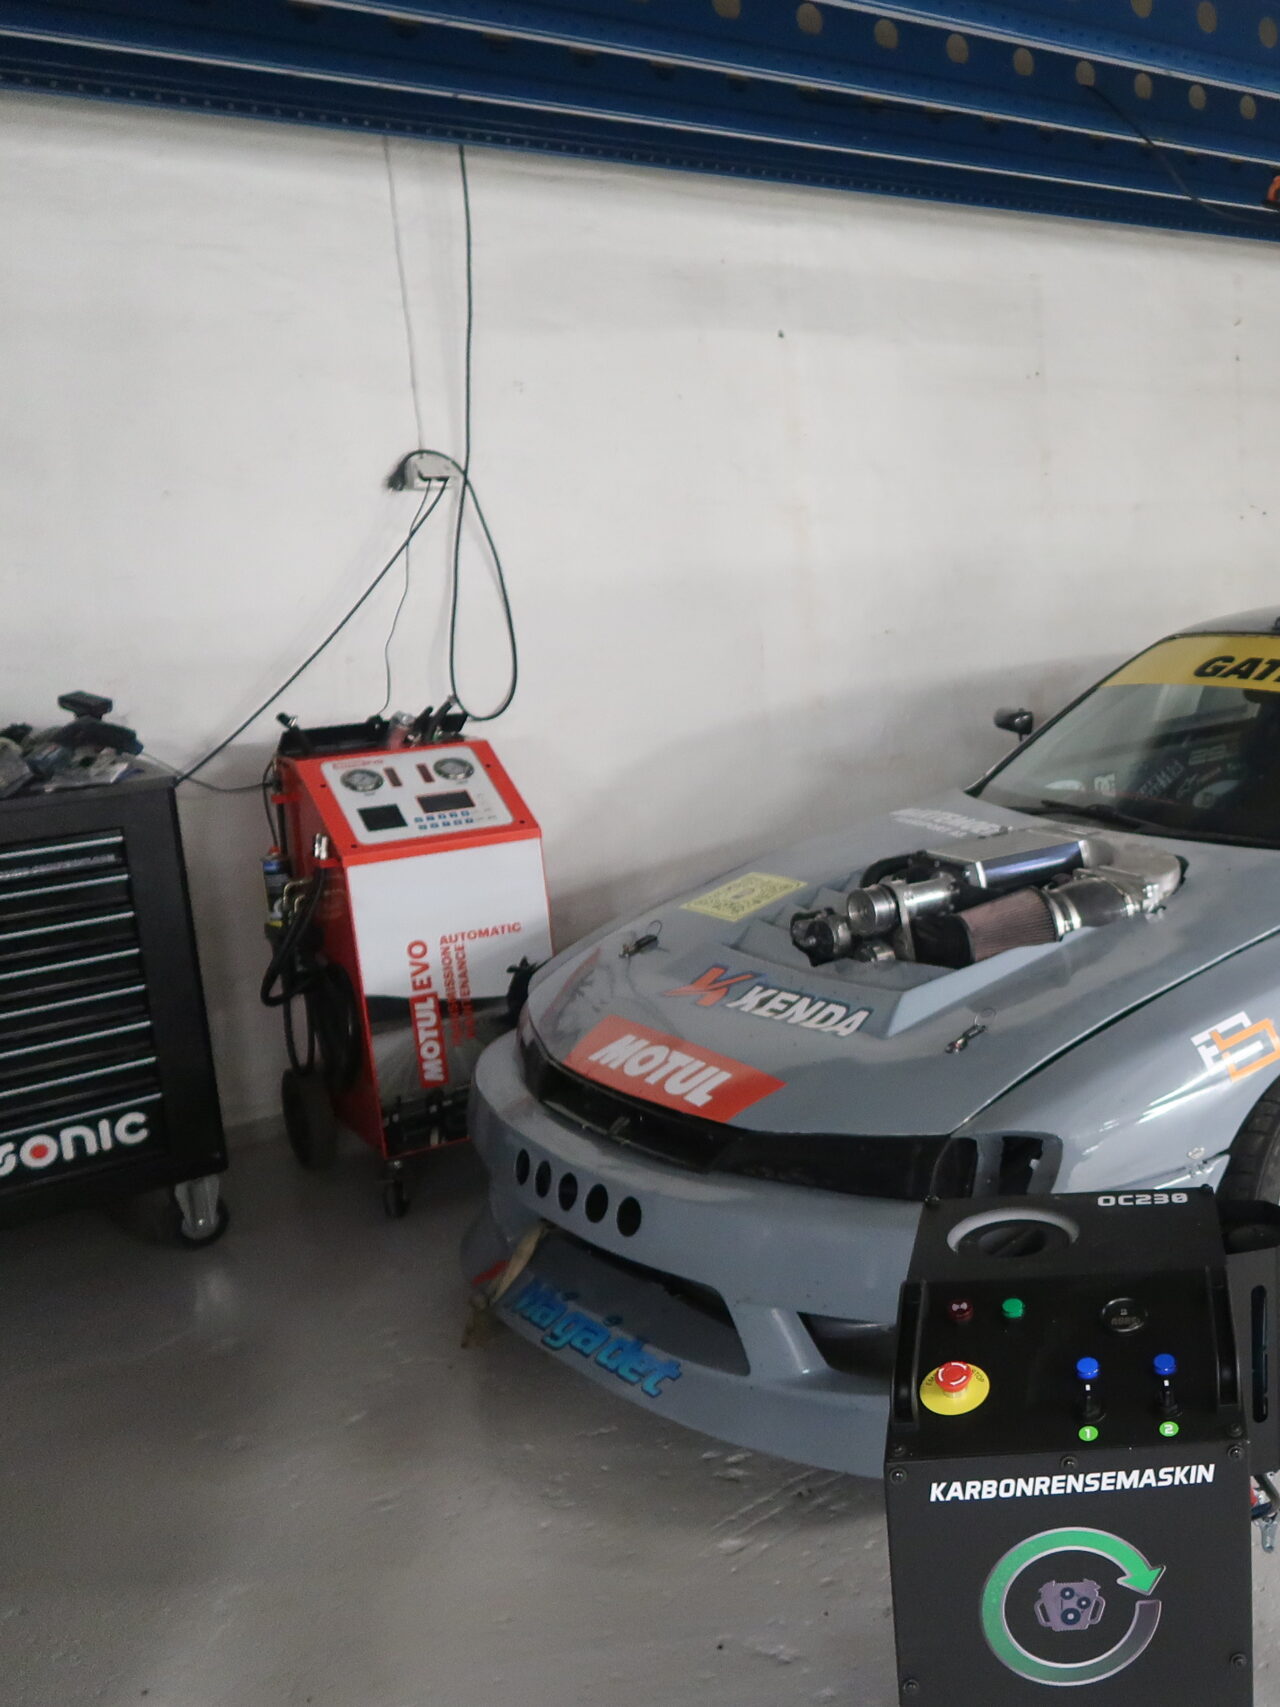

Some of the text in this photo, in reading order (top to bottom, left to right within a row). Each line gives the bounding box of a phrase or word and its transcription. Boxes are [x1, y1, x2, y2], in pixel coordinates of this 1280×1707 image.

[440, 922, 522, 945] AUTOMATIC
[407, 940, 445, 1081] MOTUL EVO
[726, 985, 871, 1037] KENDA
[588, 1034, 733, 1108] MOTUL
[1097, 1192, 1189, 1207] OC230
[1084, 1427, 1092, 1440] 1
[1163, 1423, 1175, 1435] 2
[929, 1463, 1216, 1502] KARBONRENSEMASKIN
